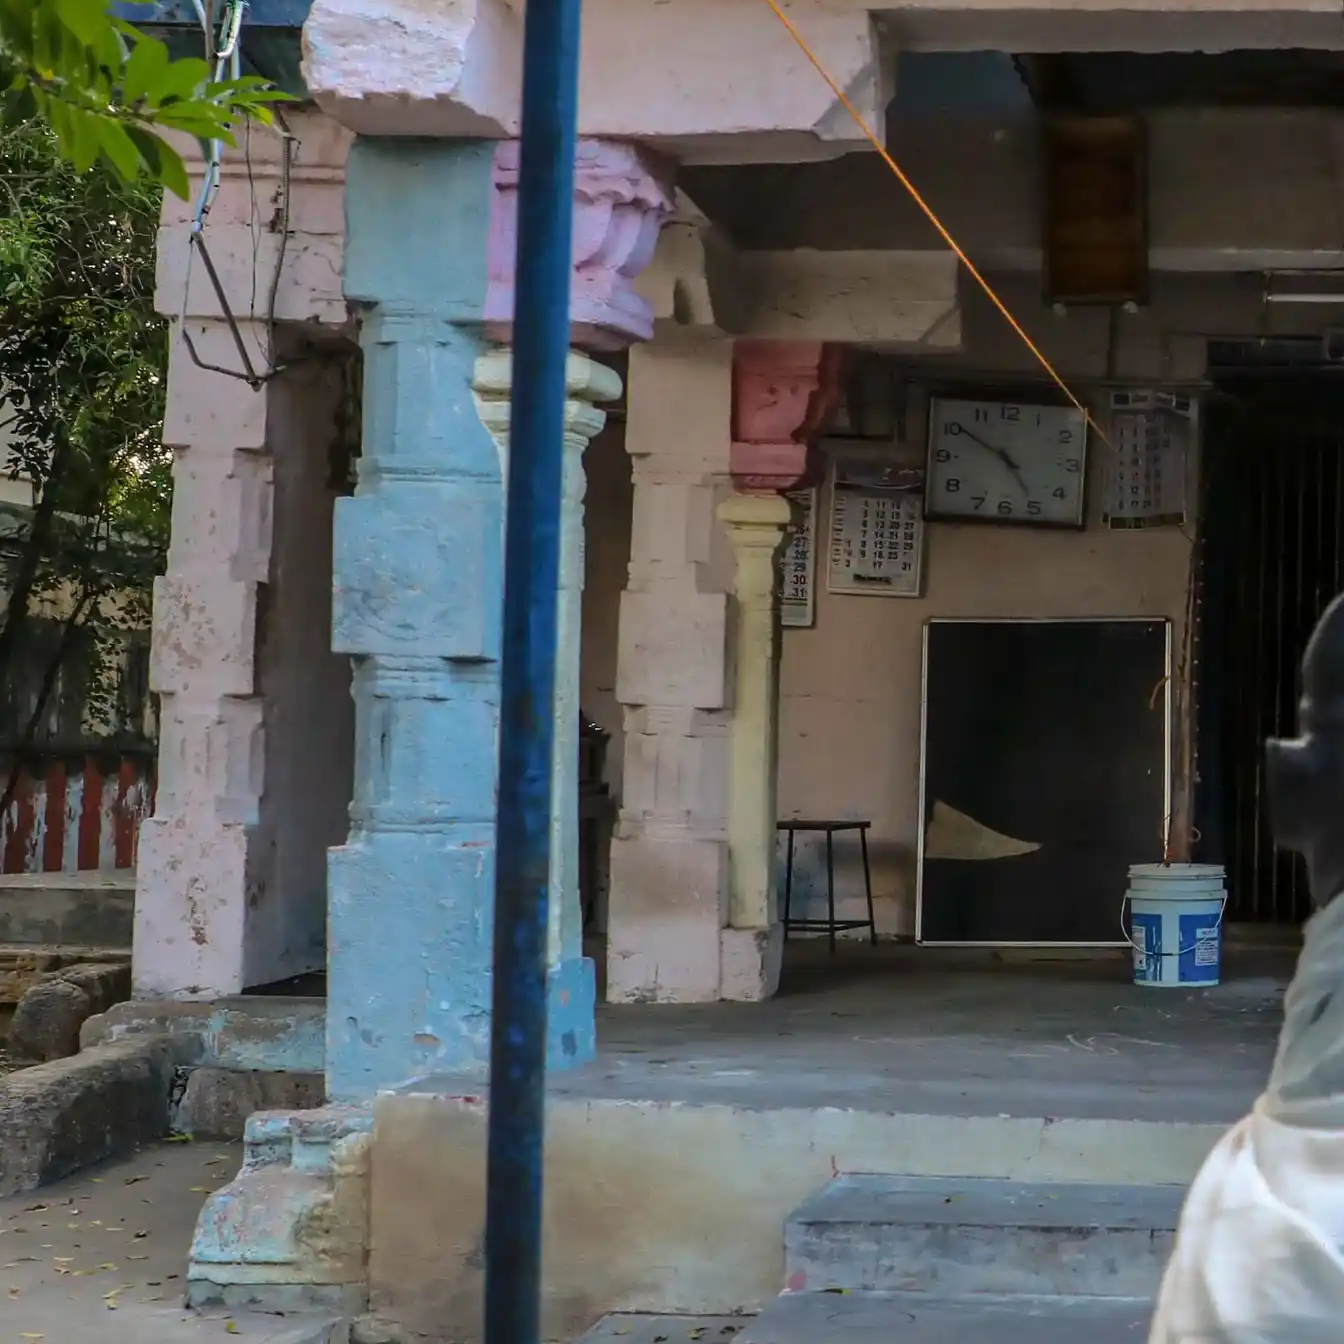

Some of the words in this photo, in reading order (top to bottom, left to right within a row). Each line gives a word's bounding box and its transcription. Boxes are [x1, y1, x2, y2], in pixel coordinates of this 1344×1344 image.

[976, 408, 988, 423] 11
[1001, 406, 1020, 421] 12
[944, 422, 962, 435] 10
[1059, 430, 1072, 443] 2
[936, 449, 950, 463] 9
[1066, 458, 1079, 472] 3
[946, 478, 960, 492] 8
[1052, 487, 1067, 500] 4
[970, 497, 985, 511] 7
[998, 501, 1012, 515] 6
[1026, 501, 1041, 515] 5
[875, 521, 885, 529] 13
[889, 521, 900, 529] 20
[904, 522, 915, 531] 27
[874, 531, 884, 539] 14
[795, 537, 806, 548] 27
[874, 540, 883, 549] 15
[888, 541, 899, 550] 22
[794, 550, 806, 560] 28
[794, 562, 806, 572] 29
[872, 560, 883, 570] 17
[901, 561, 912, 571] 31
[793, 574, 806, 585] 30
[792, 588, 805, 598] 31
